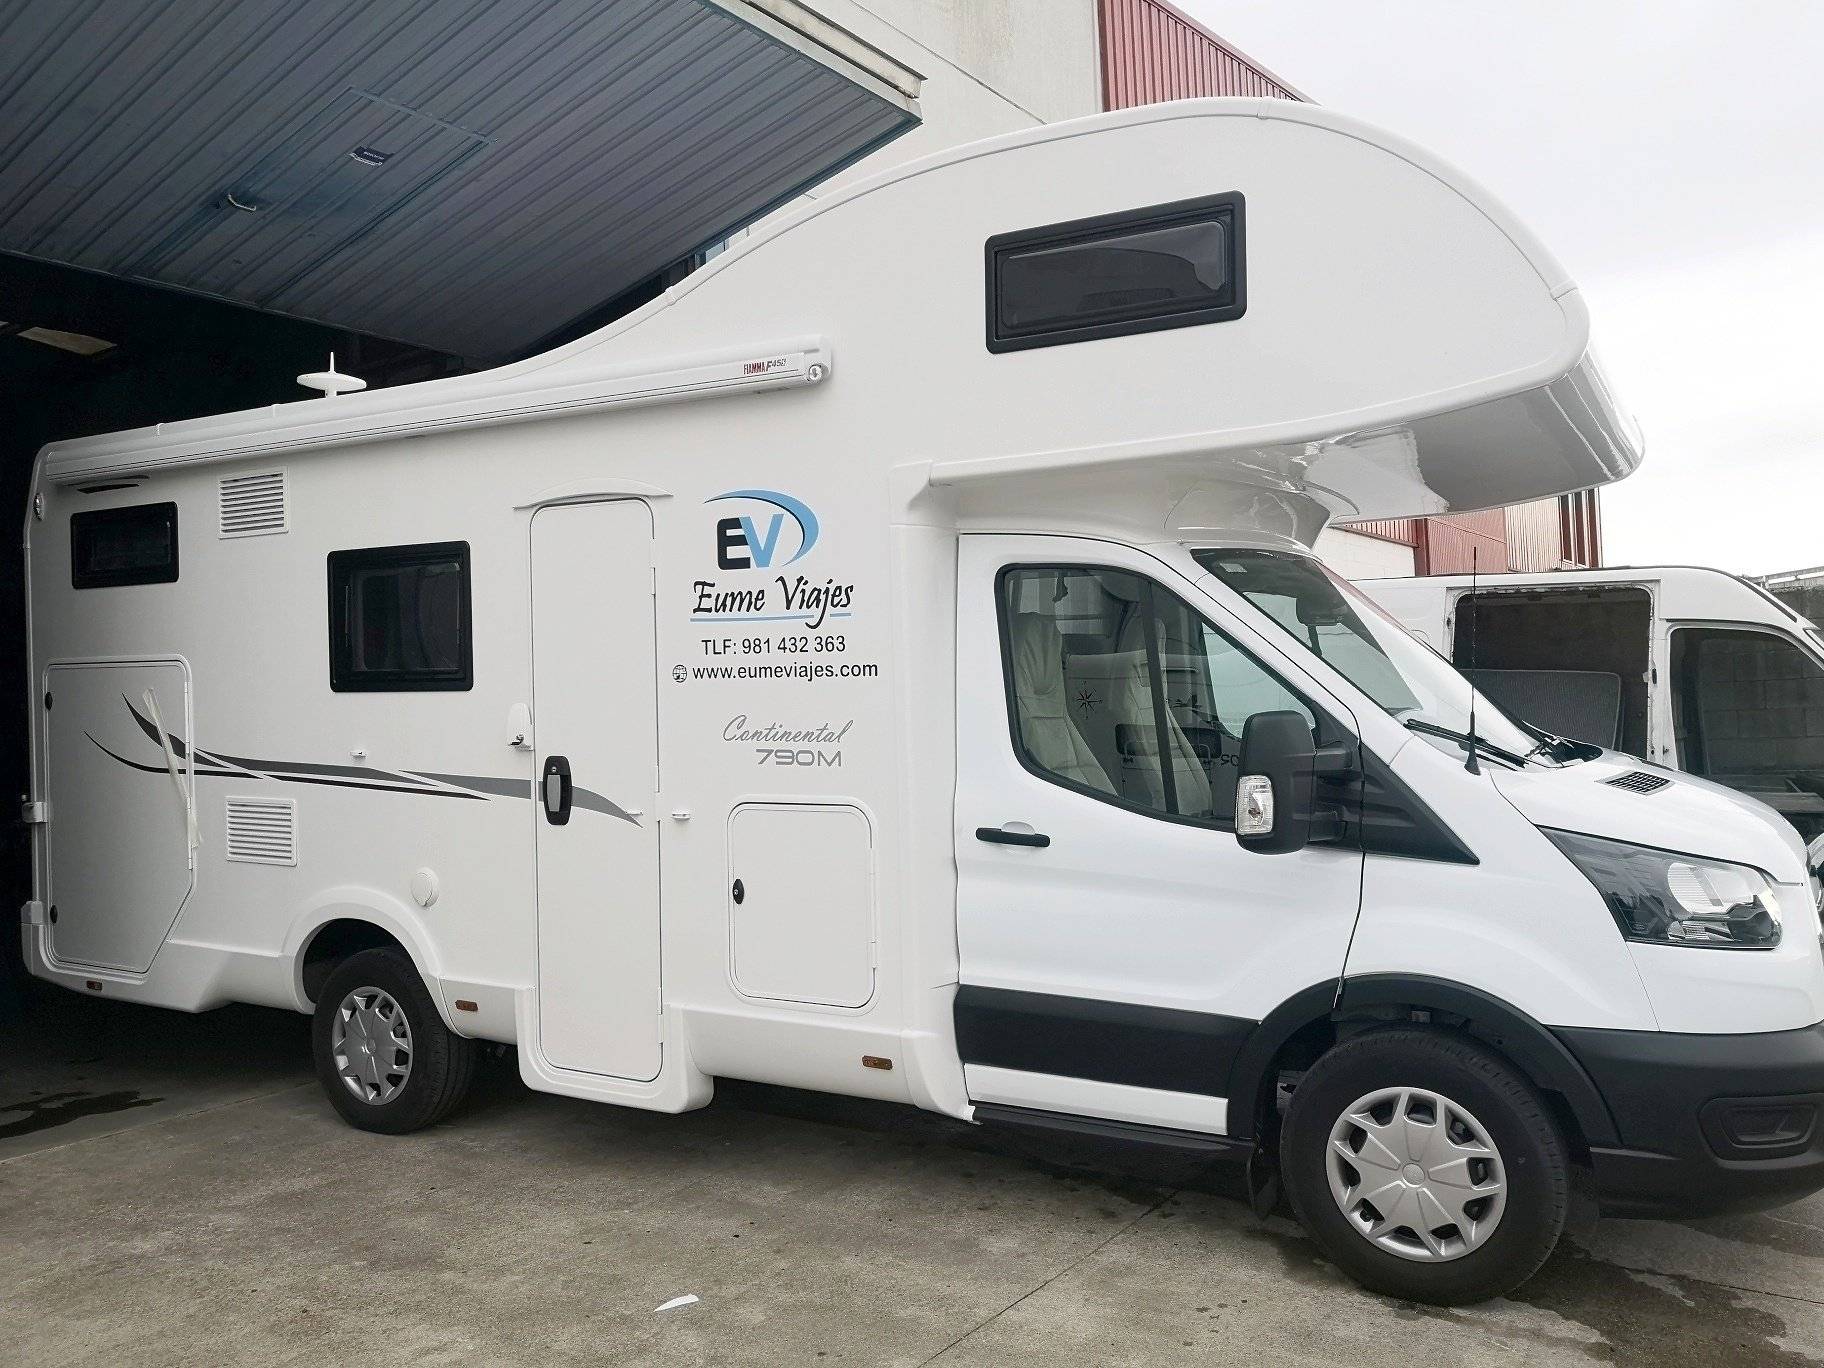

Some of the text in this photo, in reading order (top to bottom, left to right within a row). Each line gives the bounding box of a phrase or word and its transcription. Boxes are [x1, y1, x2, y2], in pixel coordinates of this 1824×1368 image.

[743, 362, 766, 375] FIAMMA
[717, 514, 784, 570] EV
[692, 575, 854, 629] Eume Viajes
[701, 635, 846, 655] TLF: 981 432 363
[692, 661, 878, 682] www.eumeviajes.com
[722, 714, 854, 743] Continental
[756, 748, 842, 767] 790M
